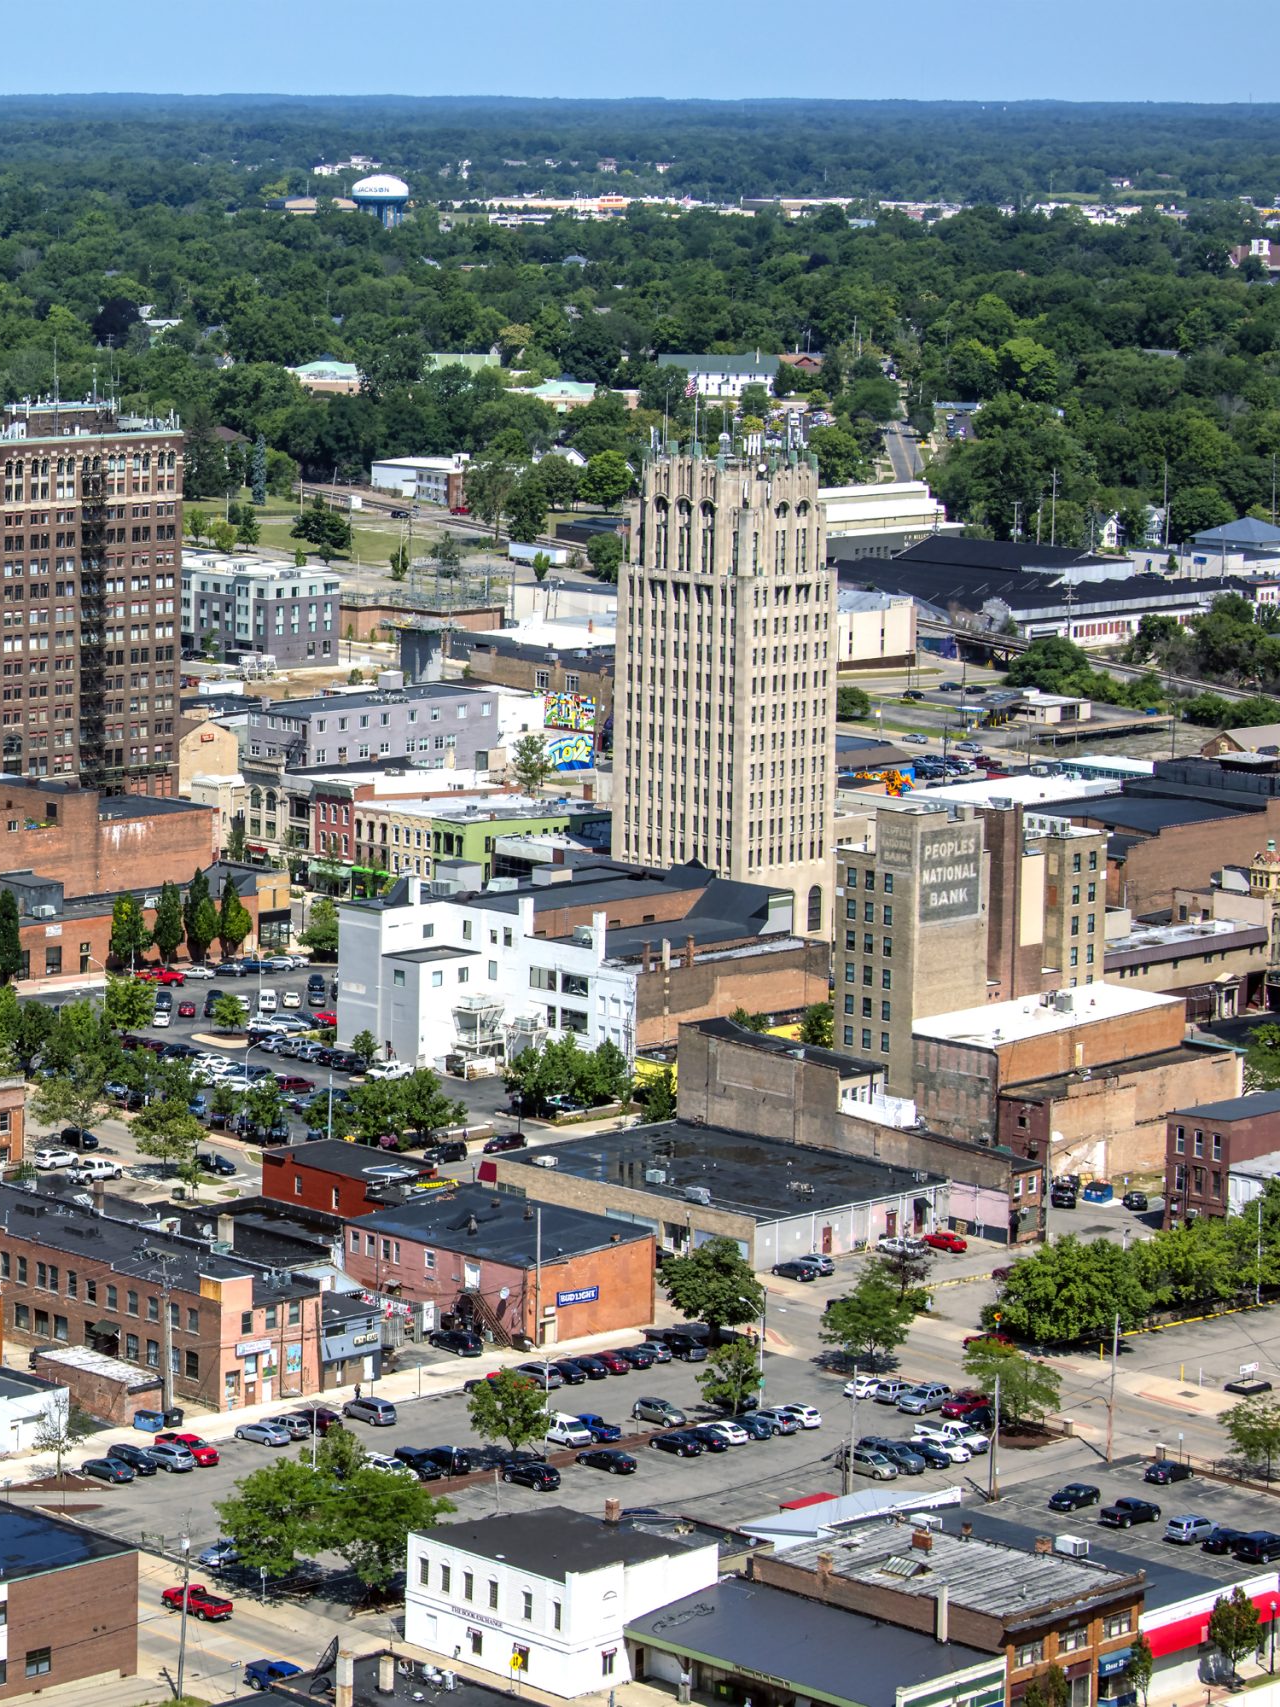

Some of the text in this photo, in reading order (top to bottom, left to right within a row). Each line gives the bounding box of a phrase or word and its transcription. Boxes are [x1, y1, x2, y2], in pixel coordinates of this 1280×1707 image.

[552, 739, 592, 766] LOVE
[924, 838, 975, 860] PEOPLES
[922, 862, 977, 886] NATIONAL
[929, 887, 969, 907] BANK
[560, 1290, 596, 1302] BUD LIGHT
[451, 1606, 503, 1628] THE BOOK EXCHANGE
